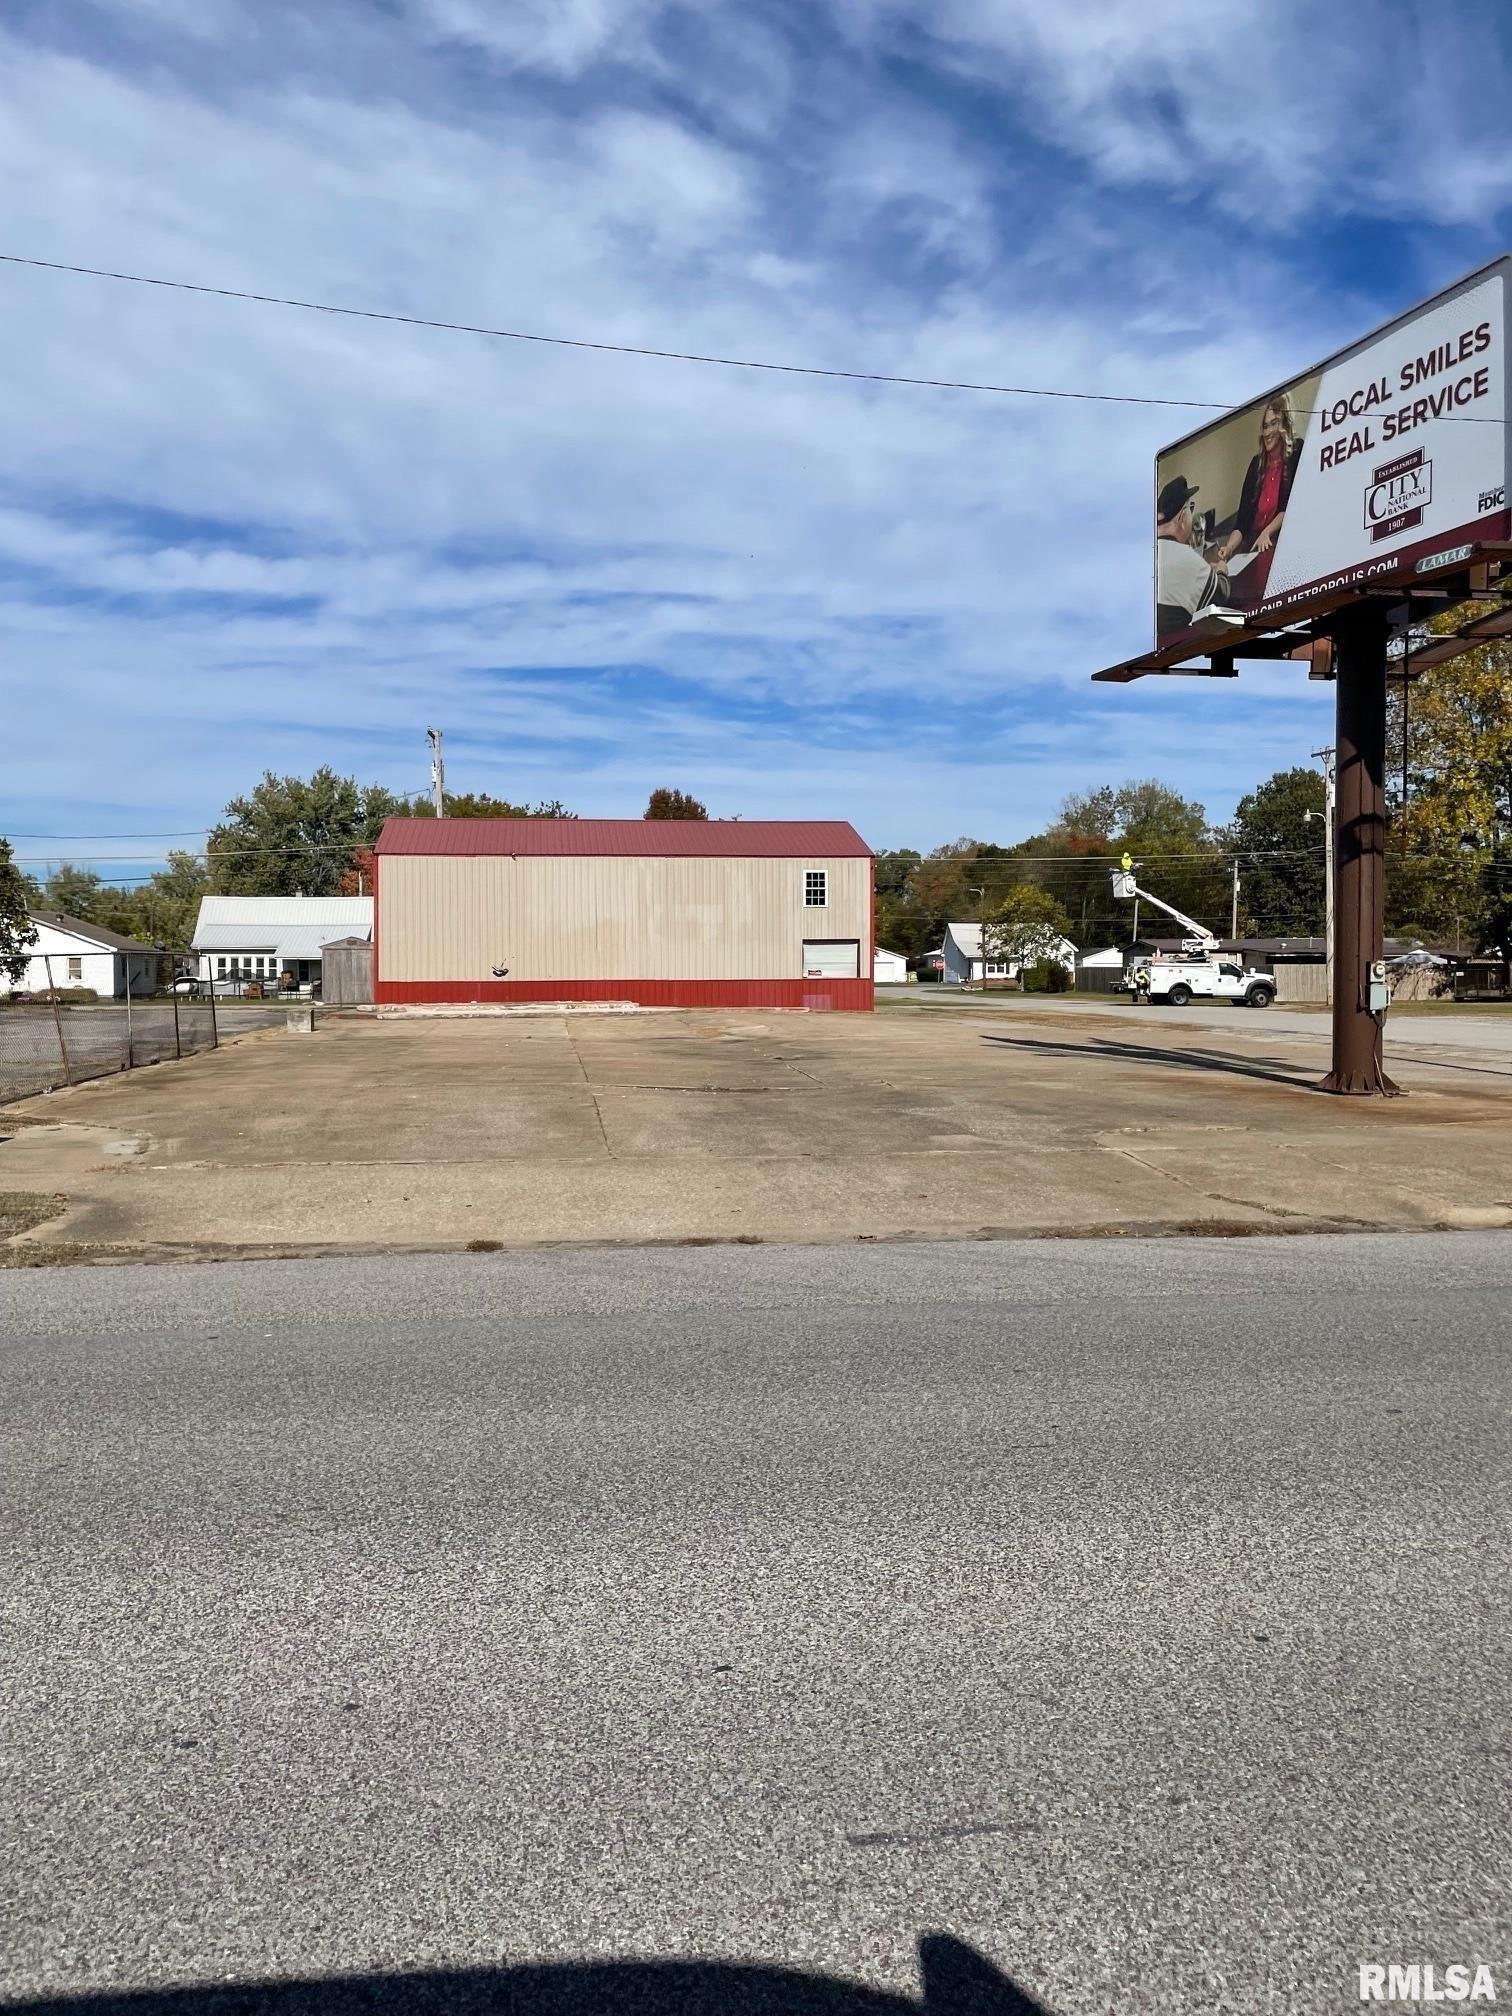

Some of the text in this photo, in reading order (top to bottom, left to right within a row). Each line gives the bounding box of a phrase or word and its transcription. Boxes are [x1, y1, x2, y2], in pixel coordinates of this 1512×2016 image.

[1320, 322, 1490, 433] LOCAL SMILES
[1320, 367, 1489, 472] REAL SERVICE
[1378, 456, 1418, 479] ESTABLISHED
[1369, 467, 1423, 520] CITY
[1388, 486, 1427, 507] NATIONAL
[1477, 490, 1504, 513] FDIC
[1388, 502, 1409, 516] BANK
[1388, 517, 1406, 532] 1907
[1421, 548, 1468, 570] LAMAR
